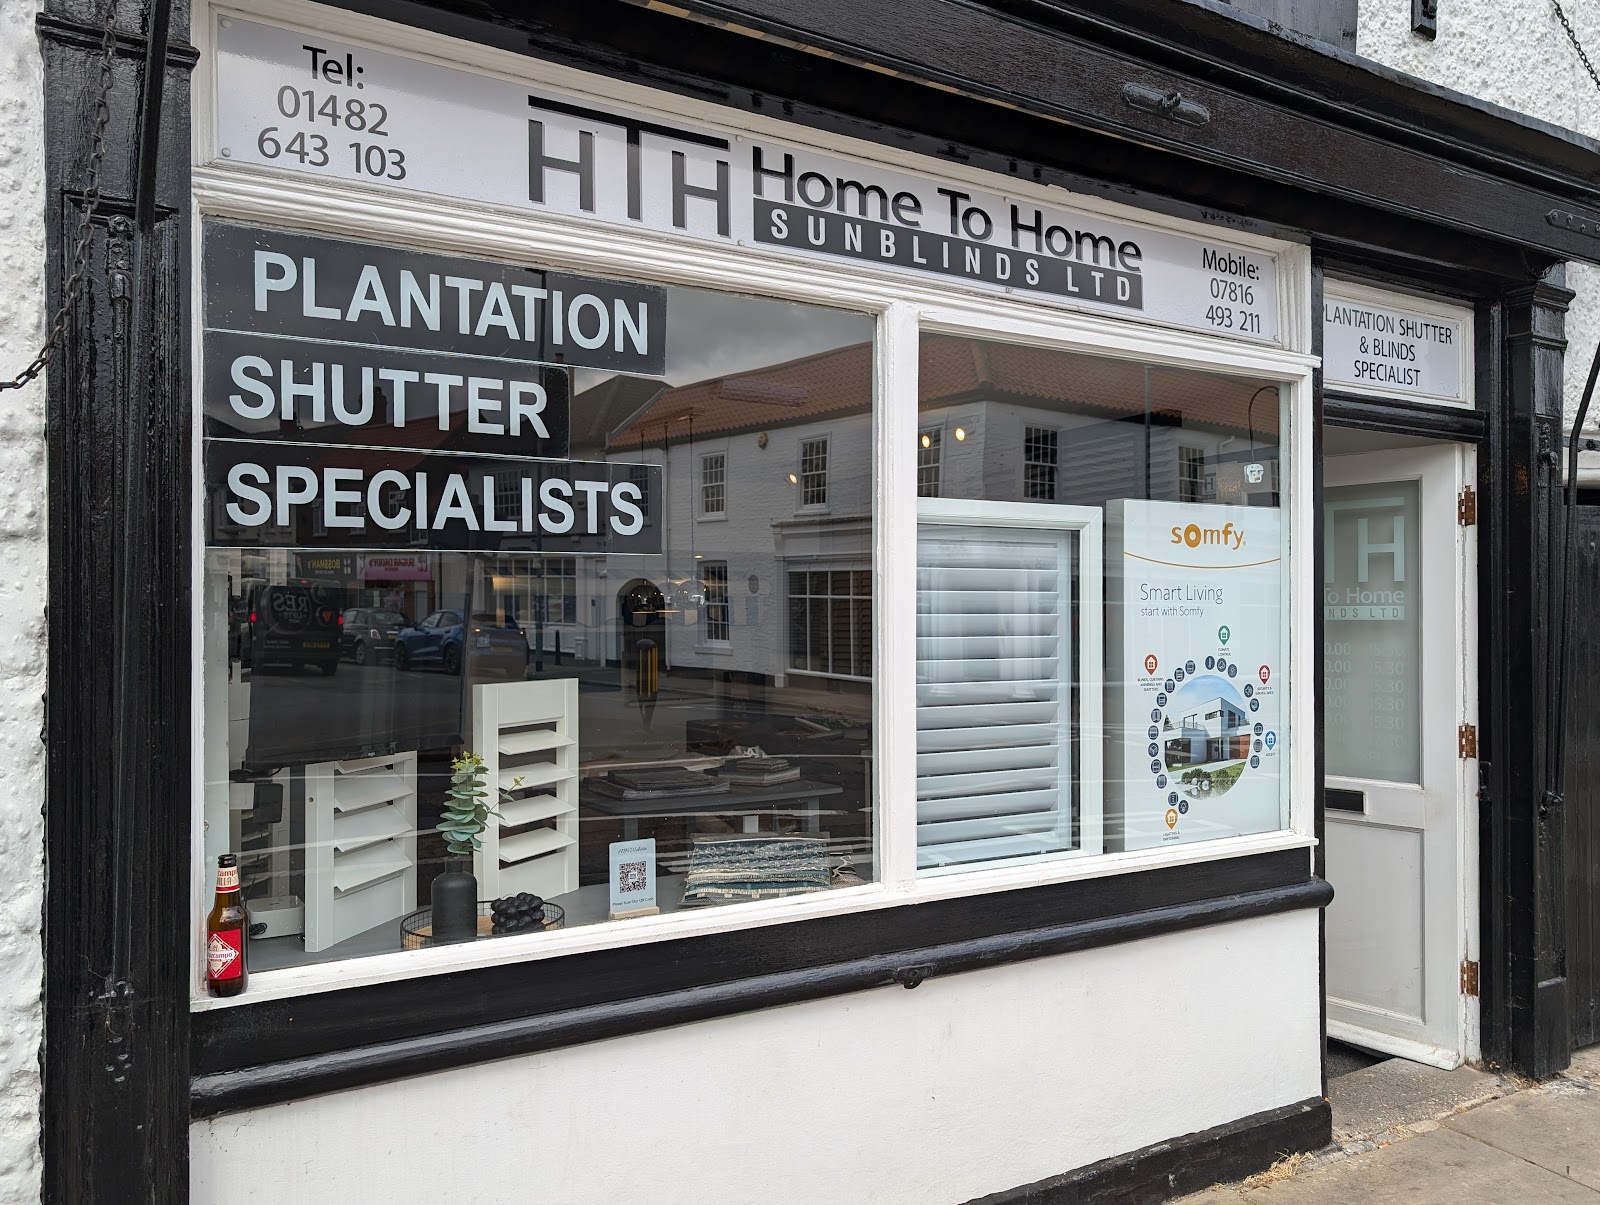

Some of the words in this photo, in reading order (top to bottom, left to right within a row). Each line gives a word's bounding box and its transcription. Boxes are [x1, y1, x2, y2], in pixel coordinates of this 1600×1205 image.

[302, 45, 364, 89] Tel:
[277, 85, 388, 137] 01482
[257, 126, 330, 167] 643
[348, 142, 407, 181] 103
[528, 95, 731, 237] HTH
[752, 146, 923, 229] Home
[937, 187, 993, 242] To
[1010, 203, 1143, 275] Home
[770, 207, 1040, 286] SUNBLINDS
[1066, 272, 1131, 302] LTD
[1202, 248, 1260, 281] Mobile:
[253, 249, 648, 356] PLANTATION
[1209, 278, 1255, 306] 07816
[1205, 306, 1234, 330] 493
[1239, 311, 1260, 334] 211
[1323, 303, 1395, 335] LANTATION
[1399, 318, 1453, 345] SHUTTER
[1359, 335, 1369, 354] &
[1373, 338, 1416, 362] BLINDS
[1354, 359, 1421, 387] SPECIALIST
[229, 355, 550, 440] SHUTTER
[226, 462, 645, 536] SPECIALISTS
[1170, 522, 1244, 551] somfy
[1140, 583, 1182, 601] Smart
[1186, 584, 1223, 605] Living
[1140, 606, 1159, 617] start
[1161, 606, 1178, 616] with
[1179, 606, 1204, 618] Somfy
[1346, 587, 1405, 604] Home
[1369, 607, 1399, 618] LTD
